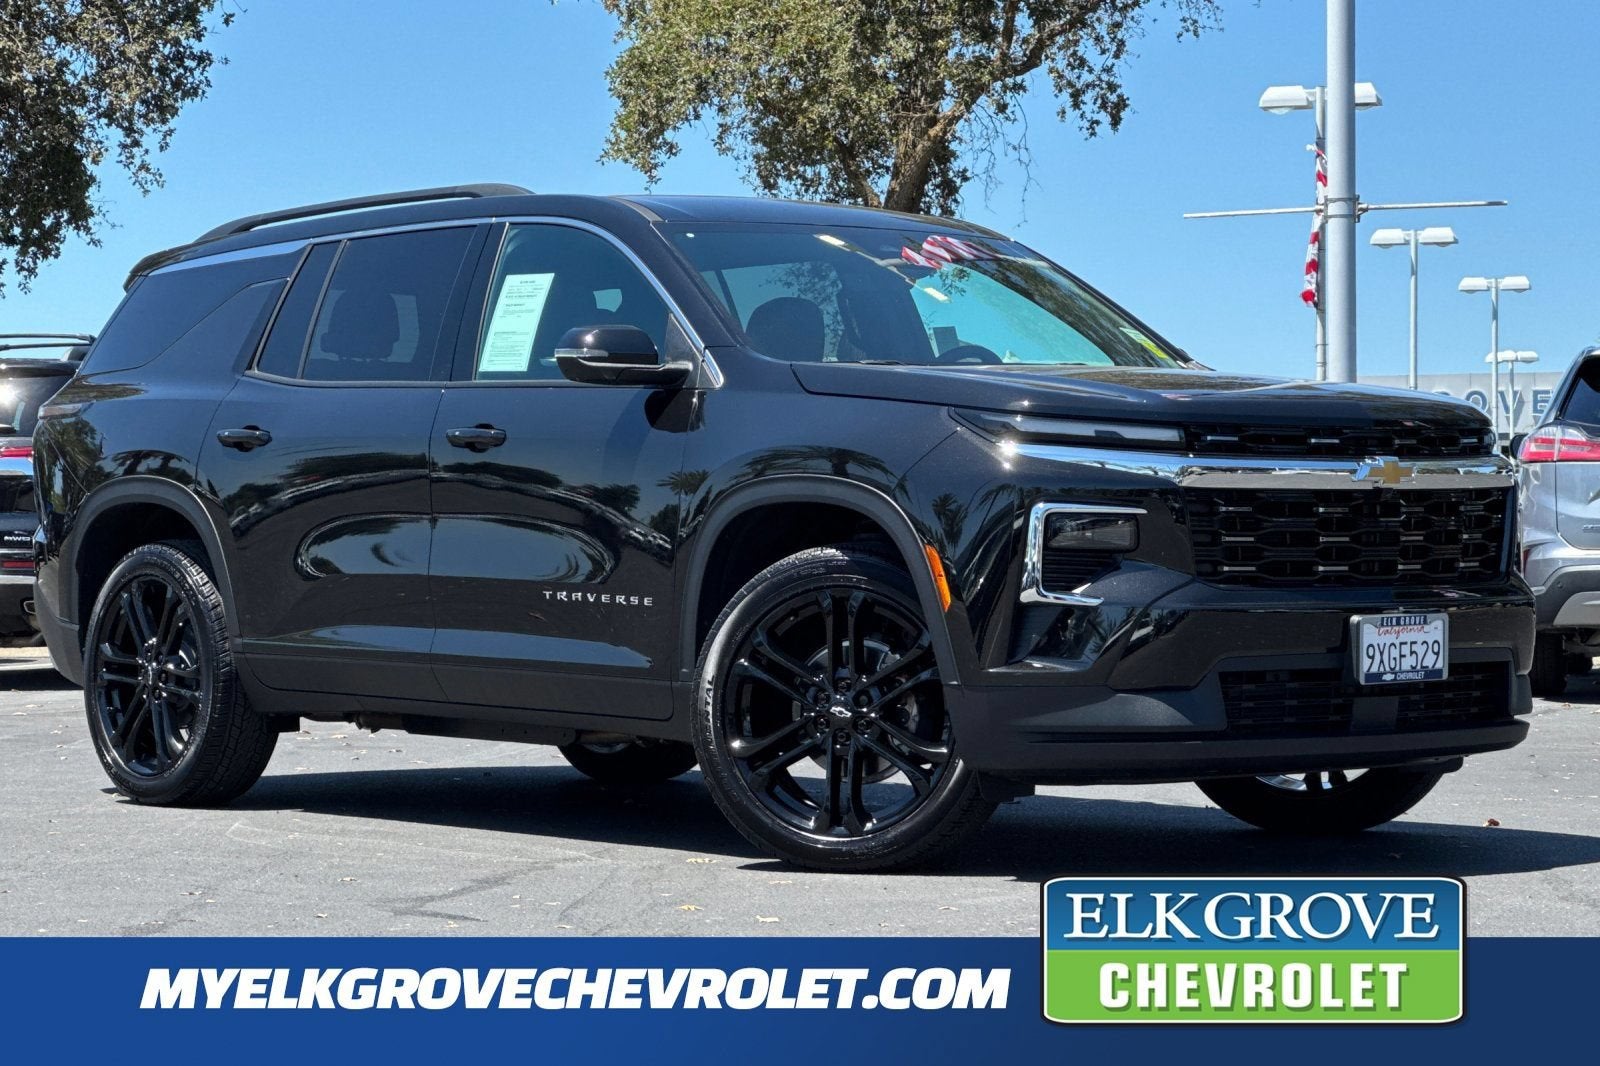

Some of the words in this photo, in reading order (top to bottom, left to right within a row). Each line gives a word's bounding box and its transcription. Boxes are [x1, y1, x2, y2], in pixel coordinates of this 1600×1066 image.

[1433, 389, 1554, 416] OVE
[542, 590, 653, 606] TRAVERSE
[1383, 616, 1397, 626] ELK
[1400, 615, 1425, 625] GROVE
[1377, 625, 1430, 639] California
[1366, 640, 1441, 672] 9XGF529
[1396, 671, 1425, 681] CHEVROLET
